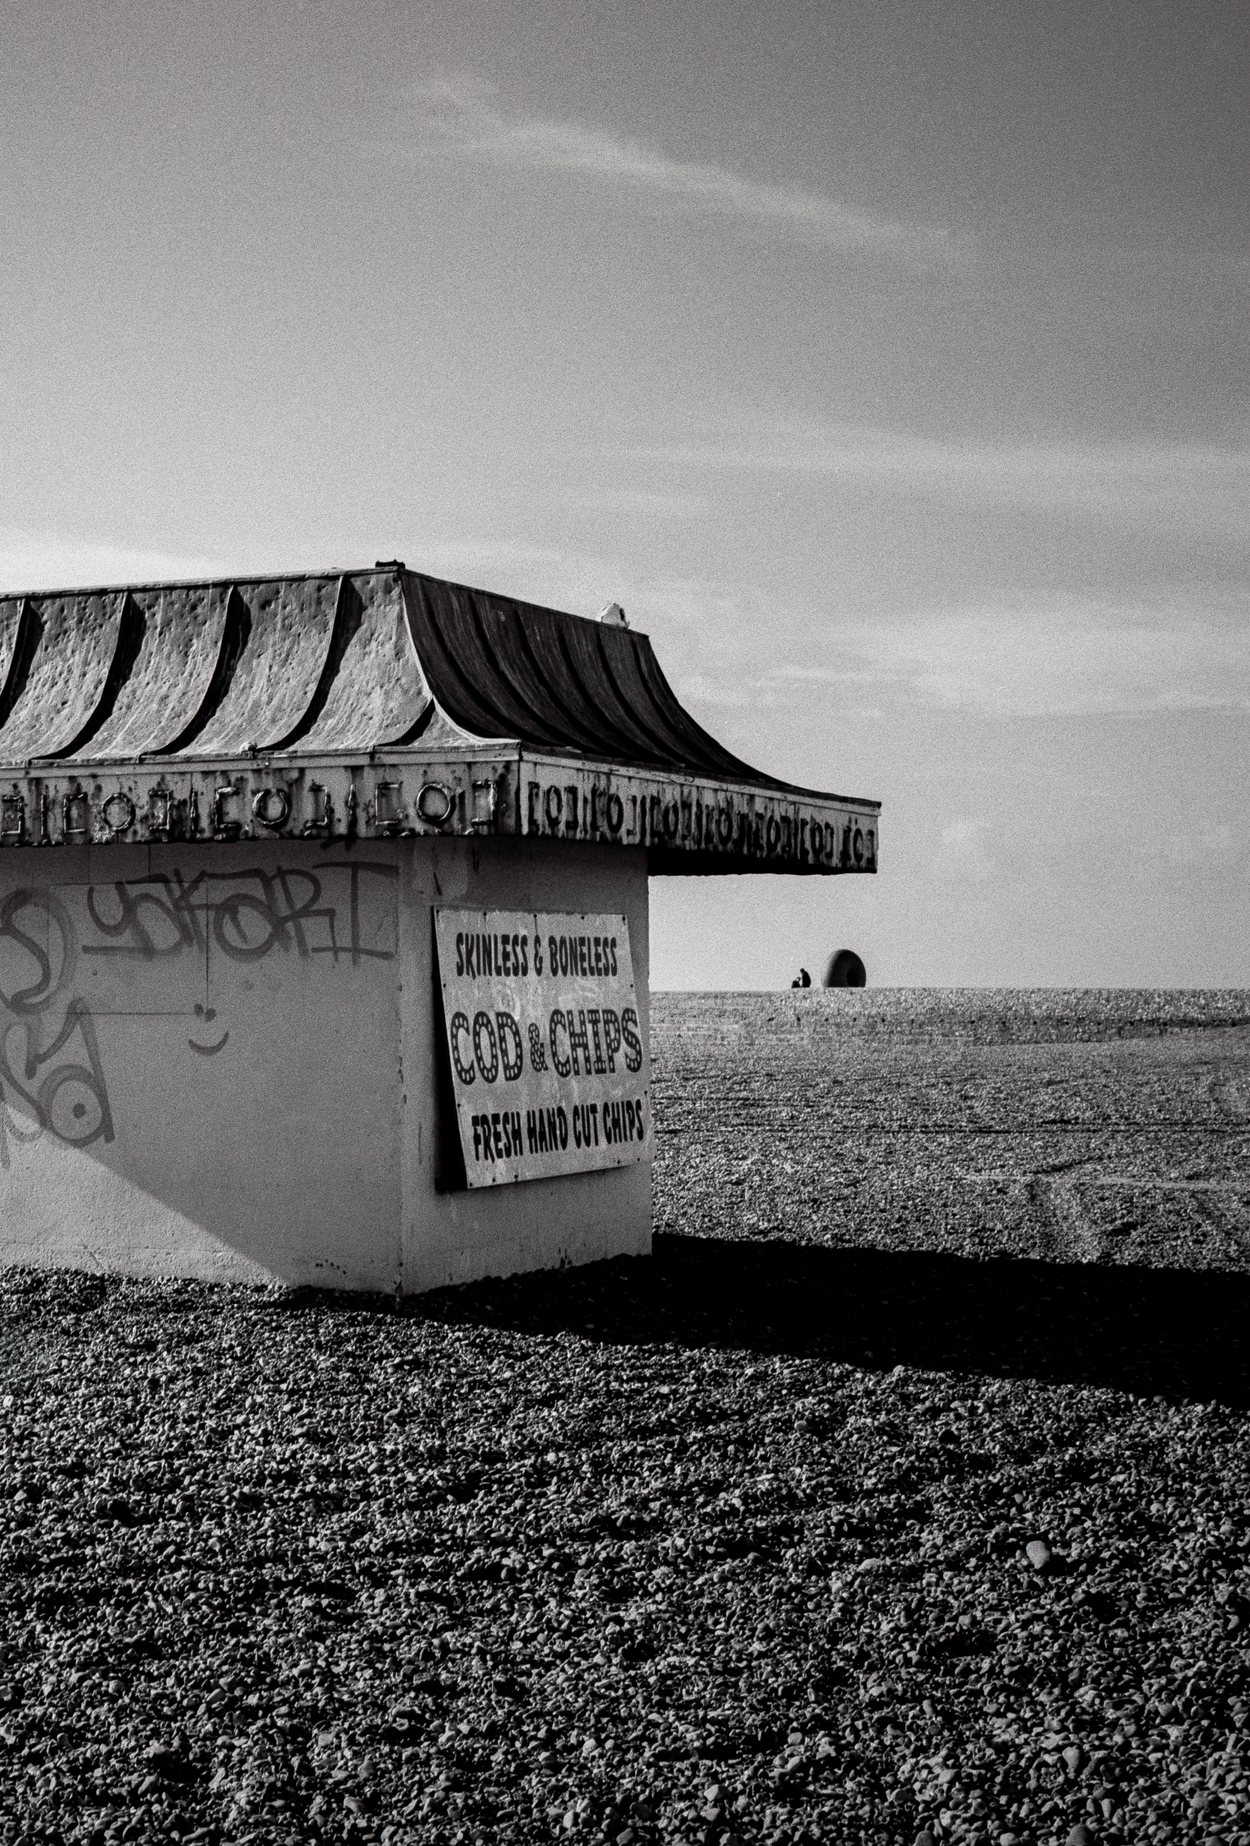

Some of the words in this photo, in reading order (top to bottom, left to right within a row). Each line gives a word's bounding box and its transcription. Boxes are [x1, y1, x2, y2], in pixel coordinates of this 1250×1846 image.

[456, 932, 528, 980] SKINLESS
[534, 934, 543, 977] &
[548, 935, 618, 977] BONELESS
[450, 1011, 523, 1085] COD
[528, 1022, 549, 1072] &
[549, 1008, 643, 1078] CHIPS
[471, 1111, 523, 1163] FRESH
[527, 1106, 568, 1154] HAND
[572, 1103, 598, 1149] CUT
[602, 1099, 644, 1145] CHIPS
